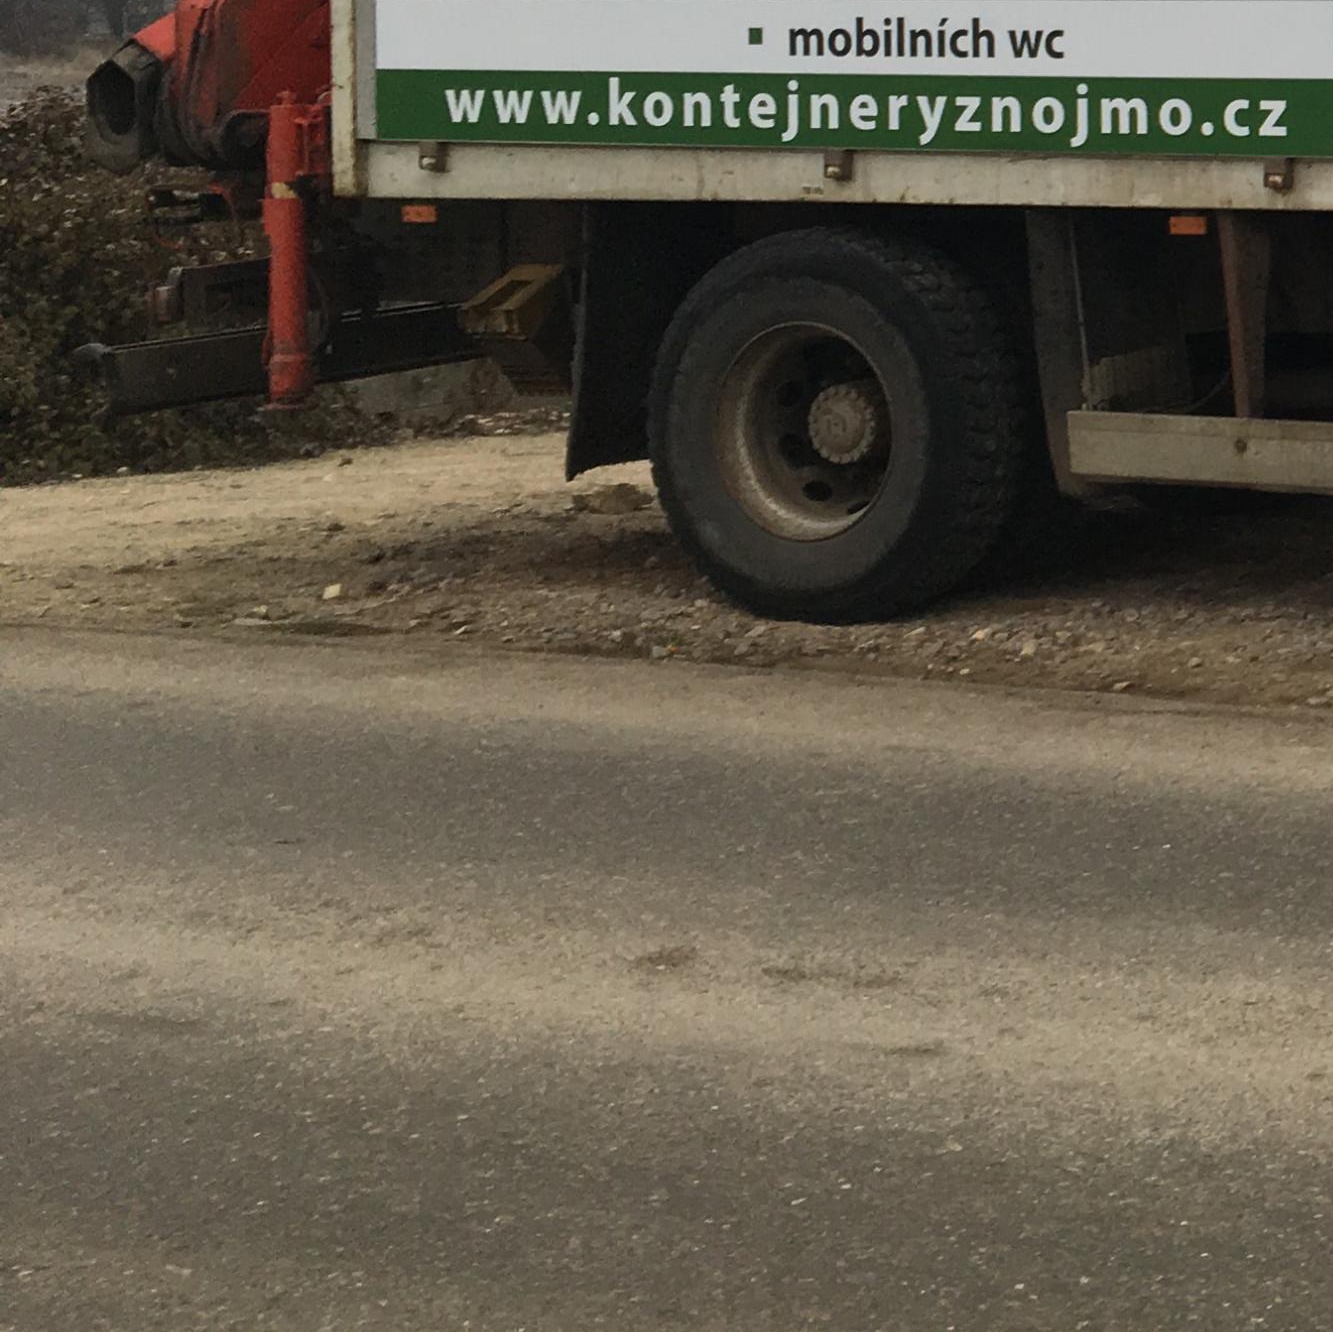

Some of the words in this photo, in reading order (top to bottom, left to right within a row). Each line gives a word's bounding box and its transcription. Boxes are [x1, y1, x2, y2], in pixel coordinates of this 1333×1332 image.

[789, 17, 995, 58] mobilních
[1008, 30, 1064, 59] wc
[445, 77, 1288, 146] www.kontejneryznojmo.cz
